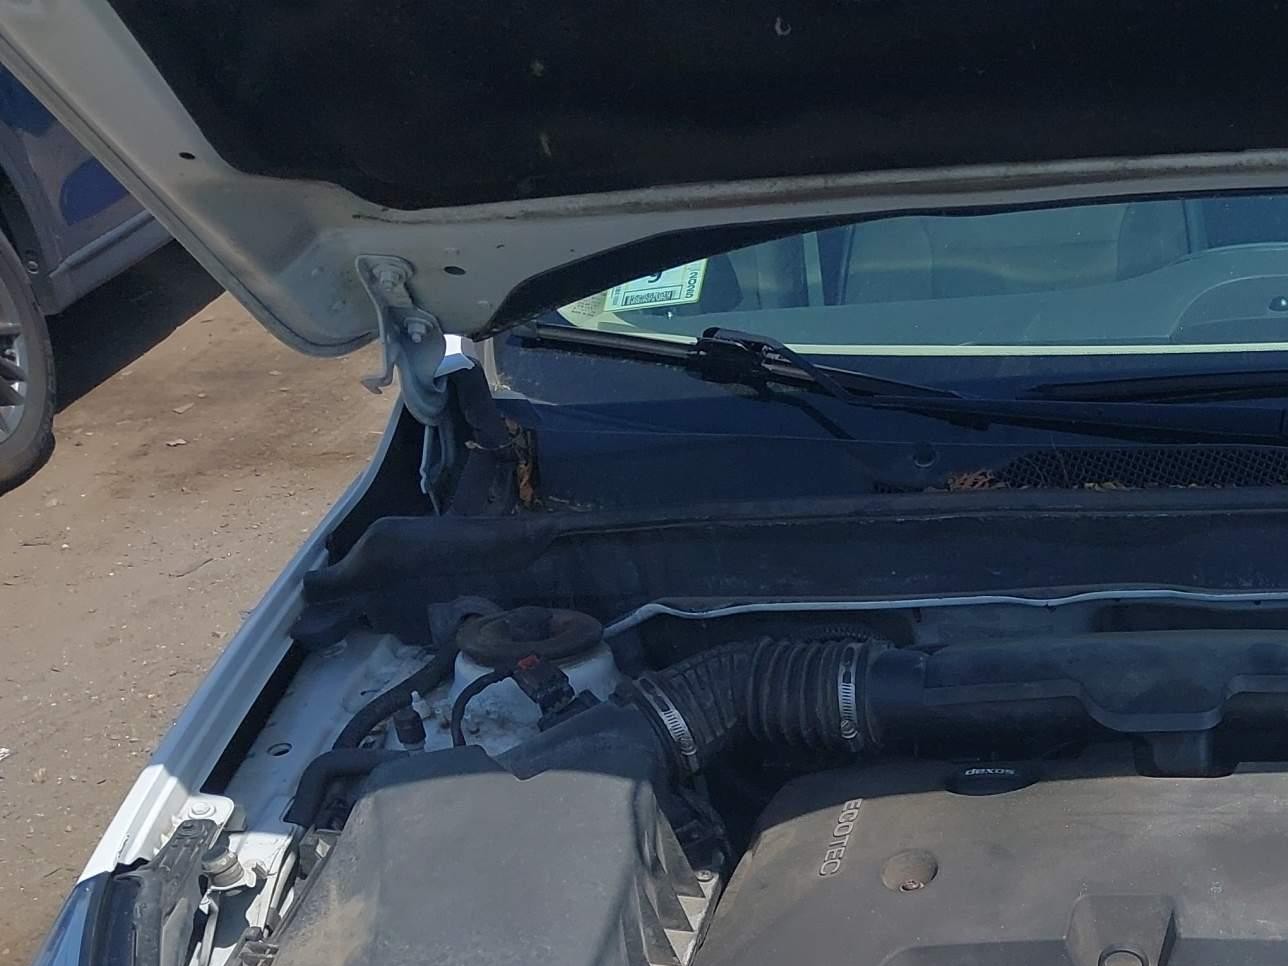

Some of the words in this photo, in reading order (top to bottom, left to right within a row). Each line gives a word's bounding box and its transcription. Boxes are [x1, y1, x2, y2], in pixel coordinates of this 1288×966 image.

[685, 271, 699, 298] 2025
[964, 768, 1015, 776] dexos
[819, 798, 863, 876] ECOTEC
